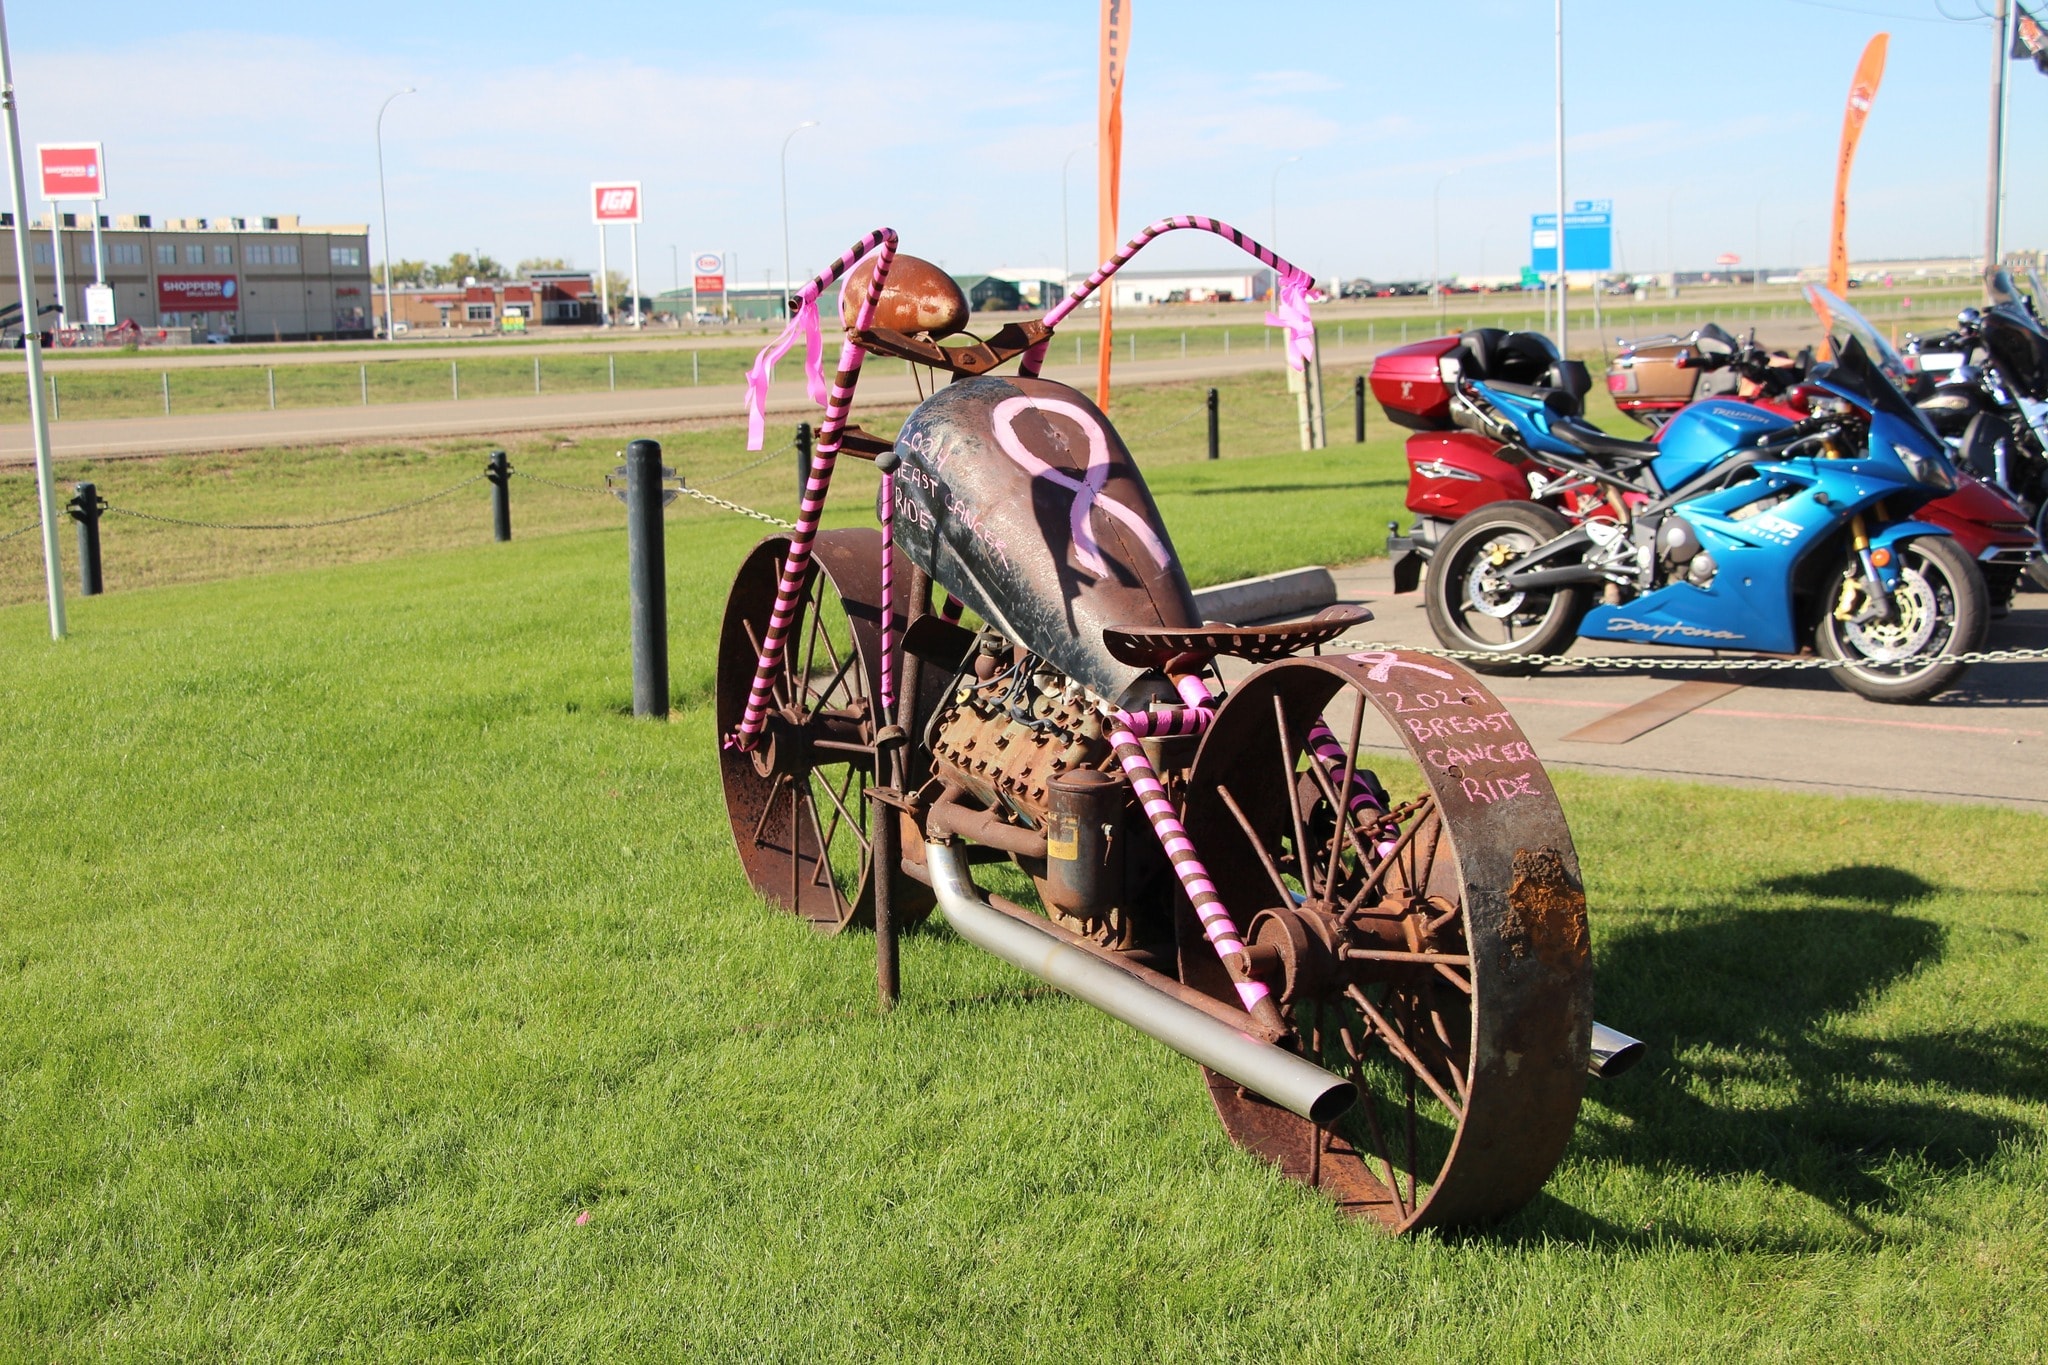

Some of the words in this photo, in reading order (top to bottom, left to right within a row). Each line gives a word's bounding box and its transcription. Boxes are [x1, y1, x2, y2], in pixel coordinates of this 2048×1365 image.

[600, 190, 635, 211] IGA
[163, 281, 222, 292] SHOPPERS
[901, 423, 951, 472] 2024
[895, 486, 933, 531] RIDE
[944, 493, 1009, 571] CANCER
[1606, 617, 1746, 640] Daytona
[1386, 686, 1488, 713] 2024
[1404, 711, 1511, 743] BREAST
[1426, 740, 1540, 769] CANCER
[1459, 772, 1542, 804] RIDE
